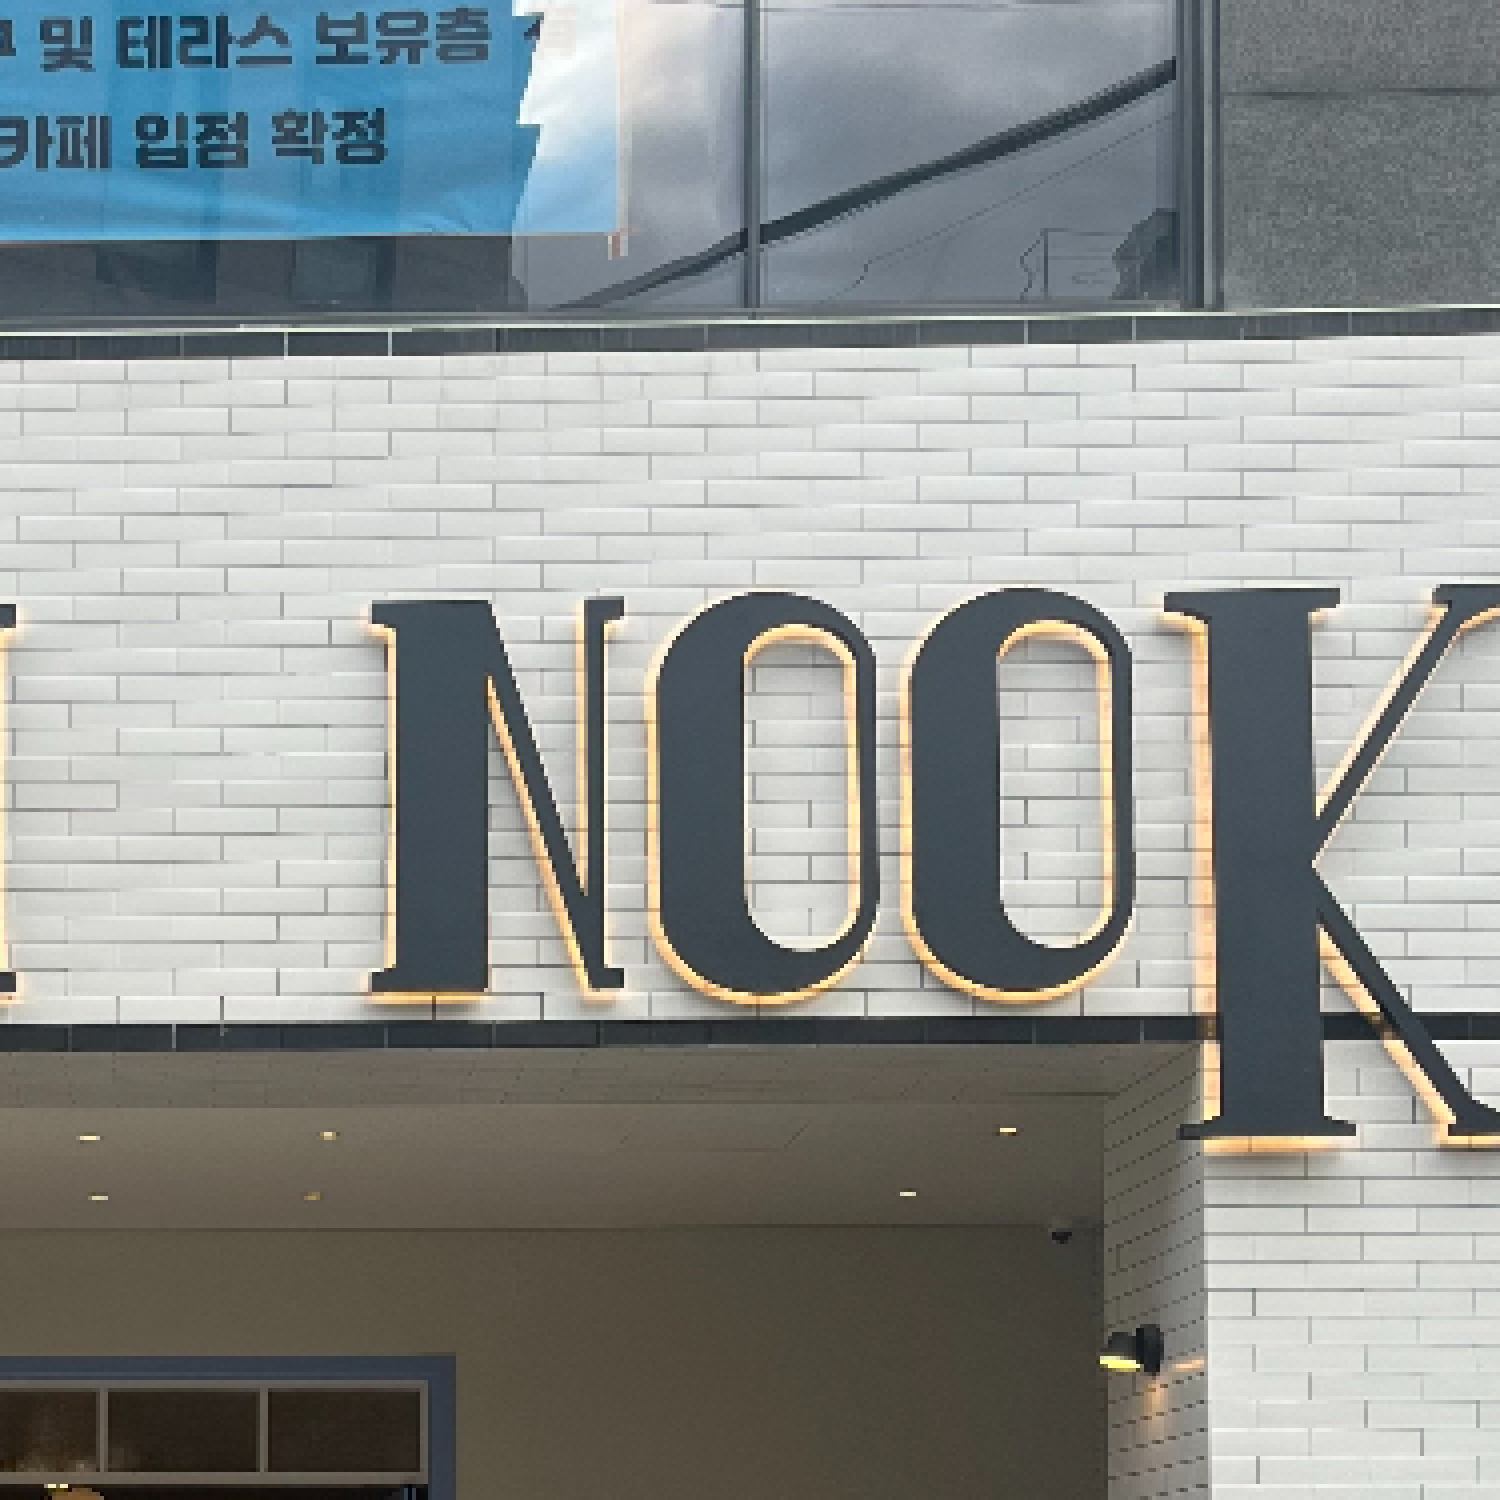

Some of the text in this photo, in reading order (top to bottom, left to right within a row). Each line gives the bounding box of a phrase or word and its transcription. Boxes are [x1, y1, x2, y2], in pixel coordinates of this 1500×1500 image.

[39, 15, 96, 73] 및
[115, 12, 293, 70] 테라스
[314, 7, 492, 66] 보유층
[135, 111, 249, 170] 입점
[270, 108, 390, 166] 확정
[371, 583, 1500, 1138] NOOK
